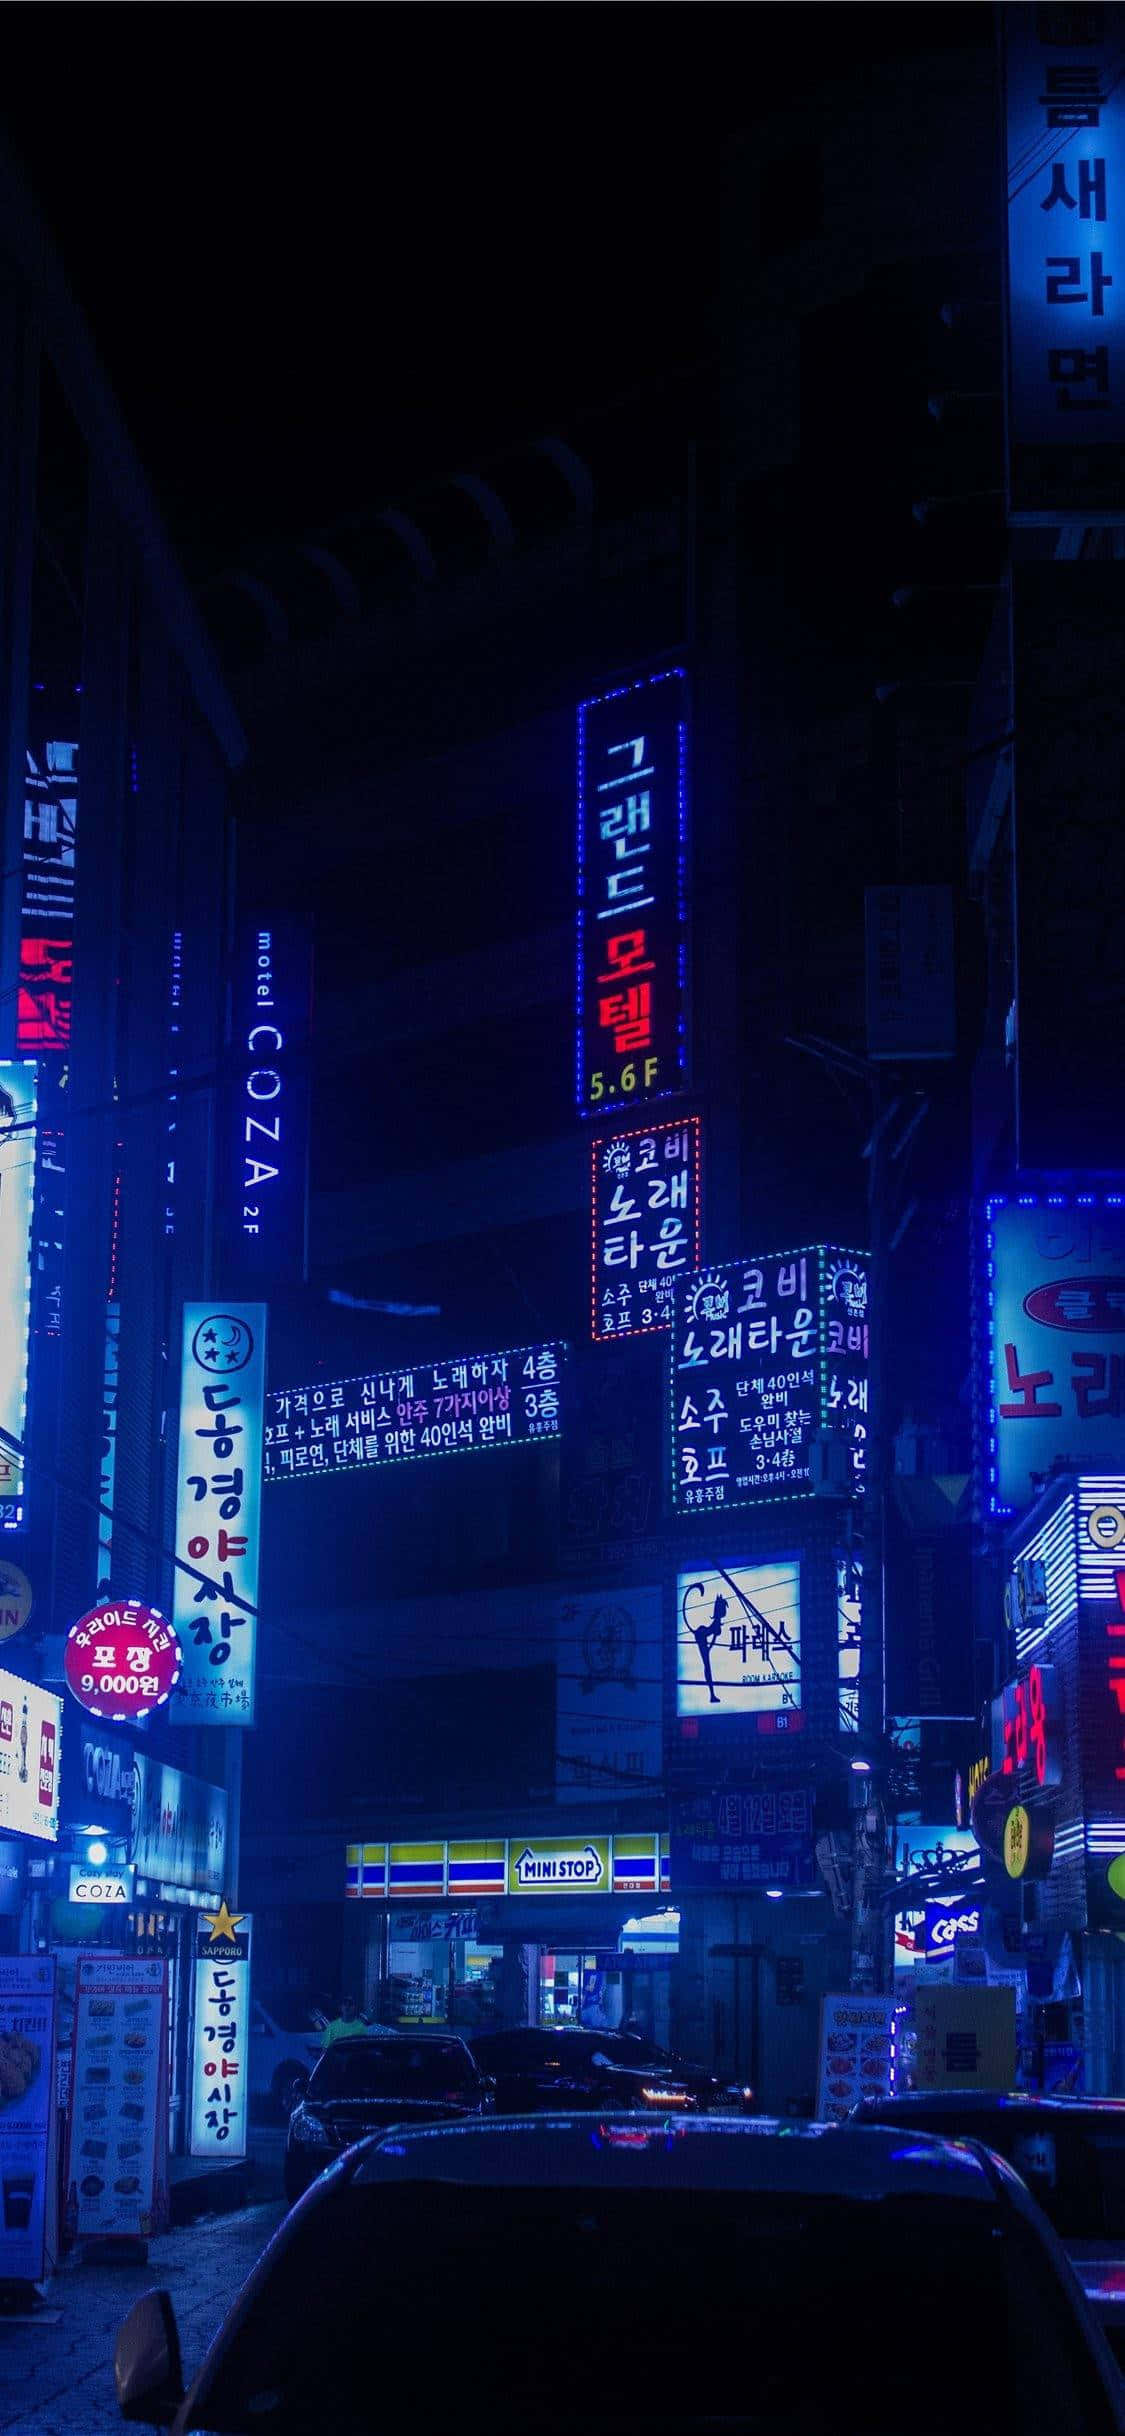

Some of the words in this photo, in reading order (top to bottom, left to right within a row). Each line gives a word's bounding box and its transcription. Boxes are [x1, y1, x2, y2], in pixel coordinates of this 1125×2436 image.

[597, 735, 656, 920] 그랜드
[256, 931, 275, 1007] motel
[597, 927, 657, 1055] 모텔
[589, 1056, 659, 1101] 5.6F
[243, 1024, 283, 1188] COZA
[634, 1128, 689, 1173] 코비
[603, 1169, 688, 1226] 노래
[242, 1206, 259, 1236] 2F
[602, 1217, 689, 1270] 타운
[602, 1283, 633, 1307] 소주
[658, 1274, 676, 1289] 40
[736, 1257, 808, 1314] 코비
[602, 1311, 633, 1334] 호프
[677, 1307, 818, 1370] 노래타운
[826, 1320, 870, 1360] 코비
[522, 1350, 558, 1381] 4층
[735, 1379, 765, 1398] 단체
[767, 1369, 815, 1391] 40인석
[276, 1387, 345, 1420] 가격으로
[360, 1374, 415, 1406] 신나게
[432, 1357, 509, 1391] 노래하자
[525, 1389, 560, 1419] 3층
[761, 1390, 789, 1410] 완비
[309, 1413, 340, 1439] 노래
[345, 1405, 392, 1435] 서비스
[396, 1399, 429, 1427] 안주
[433, 1385, 512, 1419] 7가지이상
[528, 1419, 559, 1435] 유흥주점
[677, 1388, 729, 1434] 소주
[739, 1411, 780, 1434] 도우미
[783, 1408, 812, 1428] 찾는
[280, 1443, 329, 1472] 피로연,
[333, 1435, 379, 1463] 단체를
[384, 1428, 417, 1456] 위한
[420, 1418, 474, 1448] 40인석
[479, 1412, 512, 1441] 완비
[679, 1446, 730, 1486] 호프
[684, 1485, 726, 1505] 유흥주점
[187, 1382, 249, 1667] 동경야시장
[141, 1618, 172, 1653] 치킨
[728, 1620, 794, 1664] 파레스
[80, 1673, 160, 1697] 9,000원
[524, 1859, 595, 1880] MINISTOP
[75, 1884, 127, 1899] COZA
[930, 1909, 981, 1944] Cass
[201, 1945, 243, 1957] SAPPORO
[203, 1970, 240, 2141] 동경야시장
